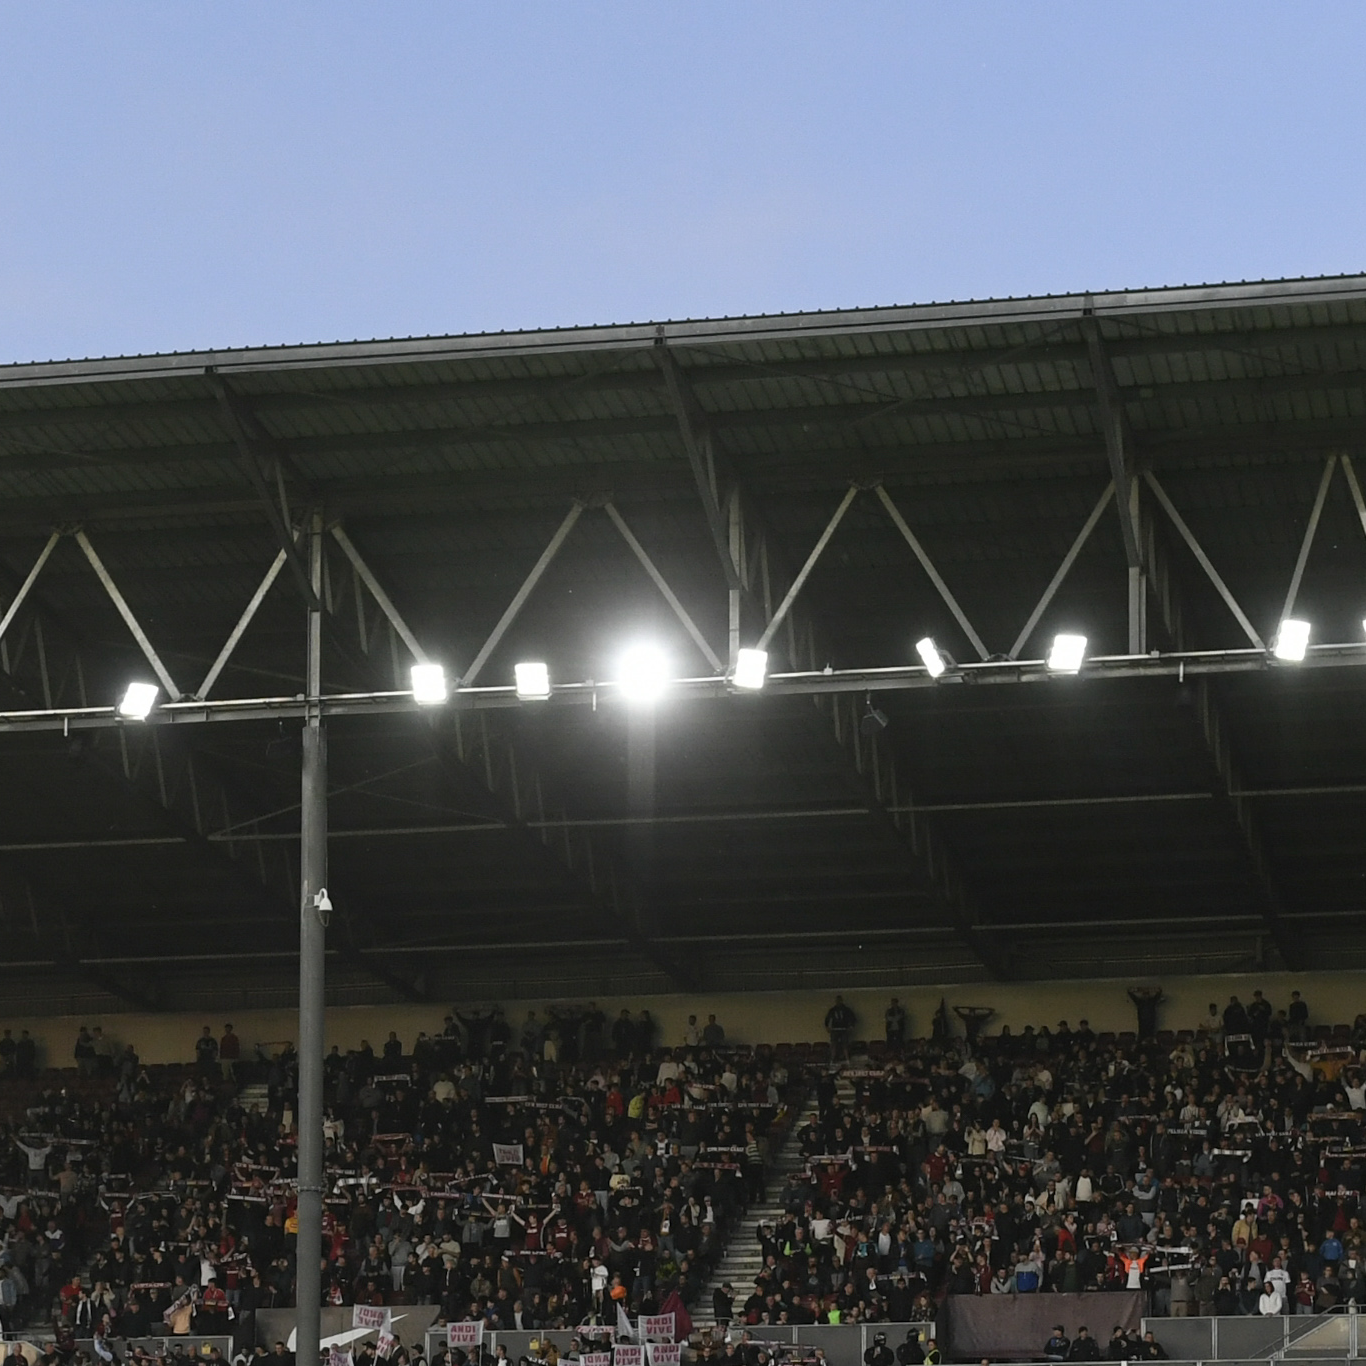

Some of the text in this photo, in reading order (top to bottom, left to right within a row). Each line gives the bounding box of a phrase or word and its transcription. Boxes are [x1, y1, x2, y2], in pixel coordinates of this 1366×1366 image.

[646, 1317, 672, 1326] ANDI
[450, 1325, 476, 1334] ANDI
[647, 1325, 673, 1334] VIVE
[451, 1334, 476, 1342] VIVE
[615, 1348, 641, 1357] ANDI
[653, 1344, 679, 1353] ANDI
[616, 1356, 641, 1365] VIVE
[653, 1353, 679, 1362] VIVE
